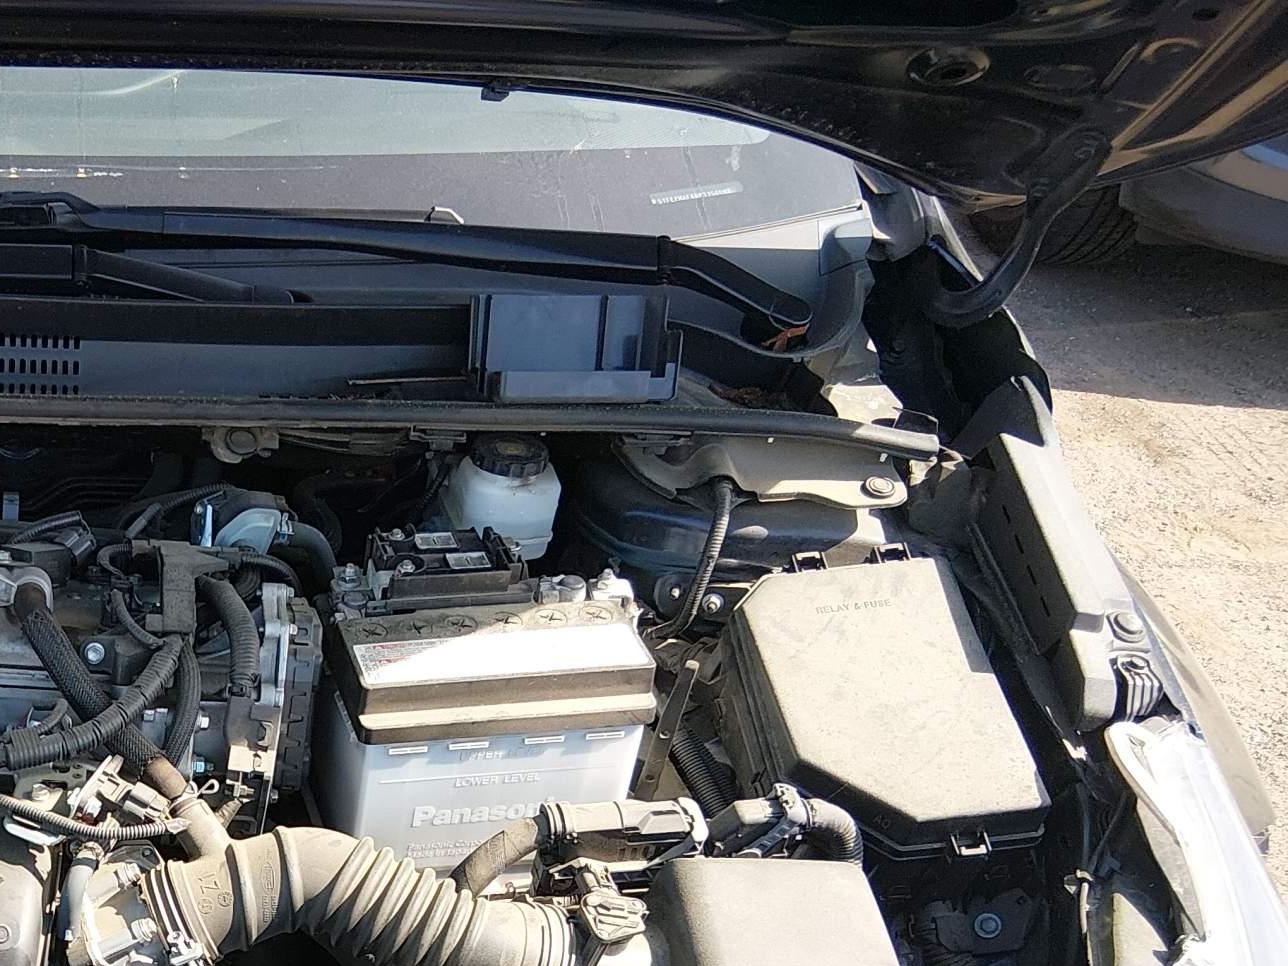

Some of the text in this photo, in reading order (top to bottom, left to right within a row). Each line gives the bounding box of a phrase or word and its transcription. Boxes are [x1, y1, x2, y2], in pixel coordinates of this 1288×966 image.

[816, 599, 892, 614] RELAY & FUSE
[455, 773, 541, 787] LOWER LEVEL
